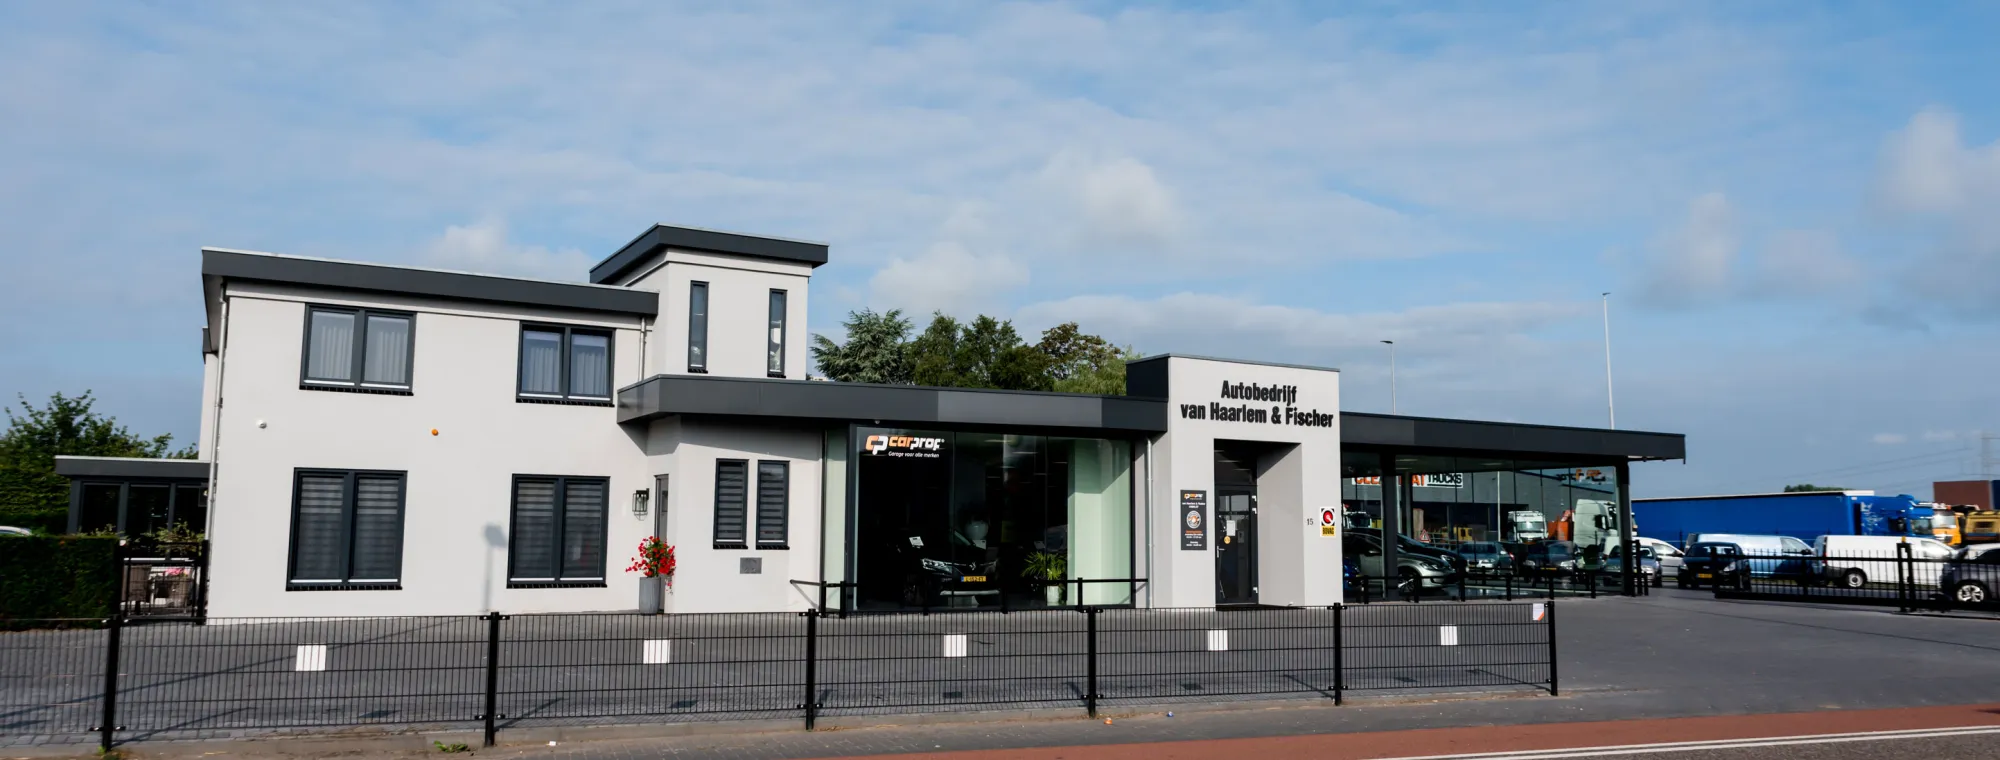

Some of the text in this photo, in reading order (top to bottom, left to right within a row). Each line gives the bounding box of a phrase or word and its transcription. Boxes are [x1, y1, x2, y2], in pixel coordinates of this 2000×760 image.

[1221, 380, 1297, 406] Autobedrijf
[1180, 402, 1334, 427] van Haarlem & Fischer
[1306, 518, 1314, 526] 15
